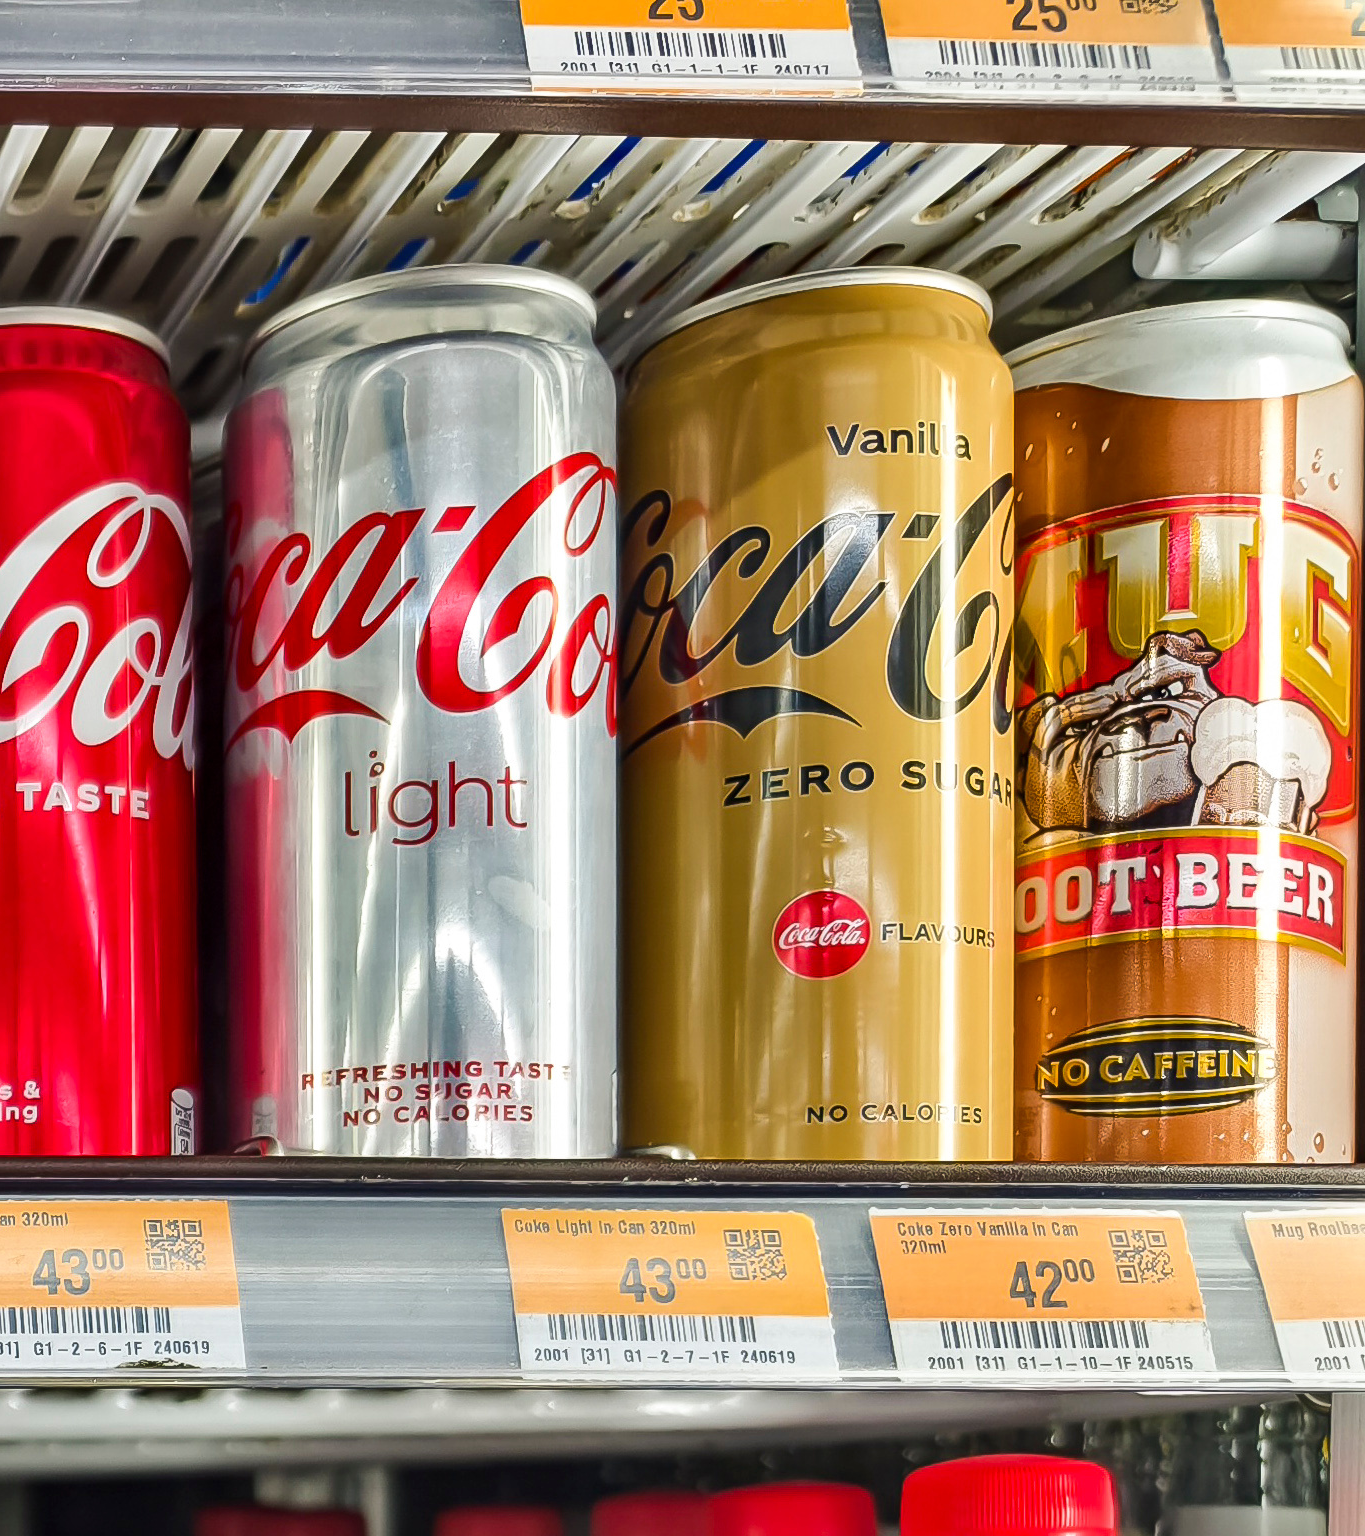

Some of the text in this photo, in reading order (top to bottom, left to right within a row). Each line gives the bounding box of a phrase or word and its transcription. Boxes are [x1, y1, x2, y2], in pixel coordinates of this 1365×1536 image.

[724, 757, 1013, 811] ZERO SUGAR
[15, 780, 152, 822] TASTE
[343, 750, 528, 845] light
[1176, 852, 1335, 926] BEER
[778, 919, 995, 950] Coca-Cola FLAVOURS
[301, 1060, 482, 1090] REFRESHING
[1037, 1048, 1278, 1094] NO CAFFEINE
[364, 1082, 512, 1104] NO SUGAR
[343, 1104, 534, 1127] NO CALORIES
[805, 1103, 983, 1125] NO CALORIES
[22, 1212, 68, 1227] 320ml
[514, 1219, 696, 1236] Coke Light Can 320ml
[897, 1221, 1078, 1237] Coke Zero Vanilla Can
[1272, 1223, 1304, 1240] Mug
[901, 1240, 947, 1254] 320ml
